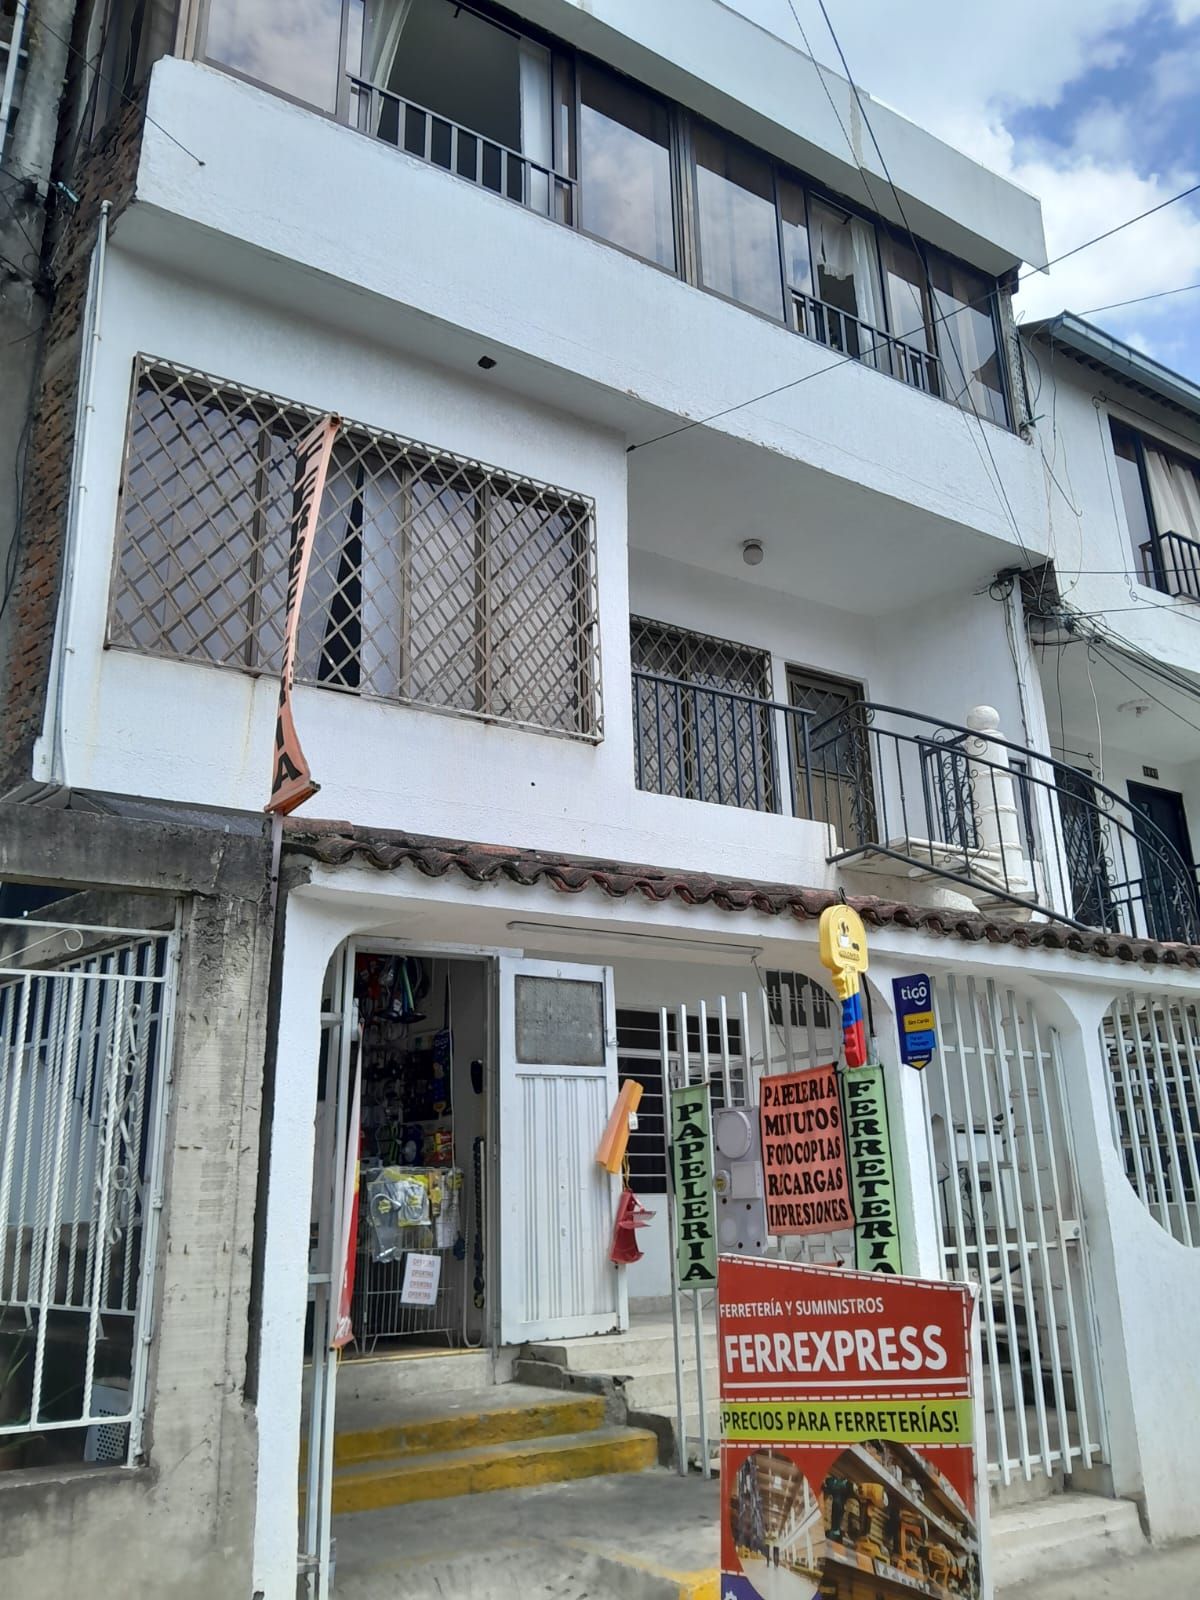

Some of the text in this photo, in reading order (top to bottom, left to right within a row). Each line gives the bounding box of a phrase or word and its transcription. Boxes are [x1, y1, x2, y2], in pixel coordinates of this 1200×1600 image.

[901, 982, 928, 1004] tigo
[764, 1105, 839, 1136] MINUTOS
[674, 1102, 716, 1281] PAPELERIA
[847, 1079, 897, 1275] FERRETERIA
[719, 1297, 884, 1318] FERRETERÍA Y SUMINISTROS
[724, 1325, 948, 1373] FERREXPRESS
[788, 1411, 831, 1432] PARA
[836, 1405, 959, 1433] FERRETERÍAS!
